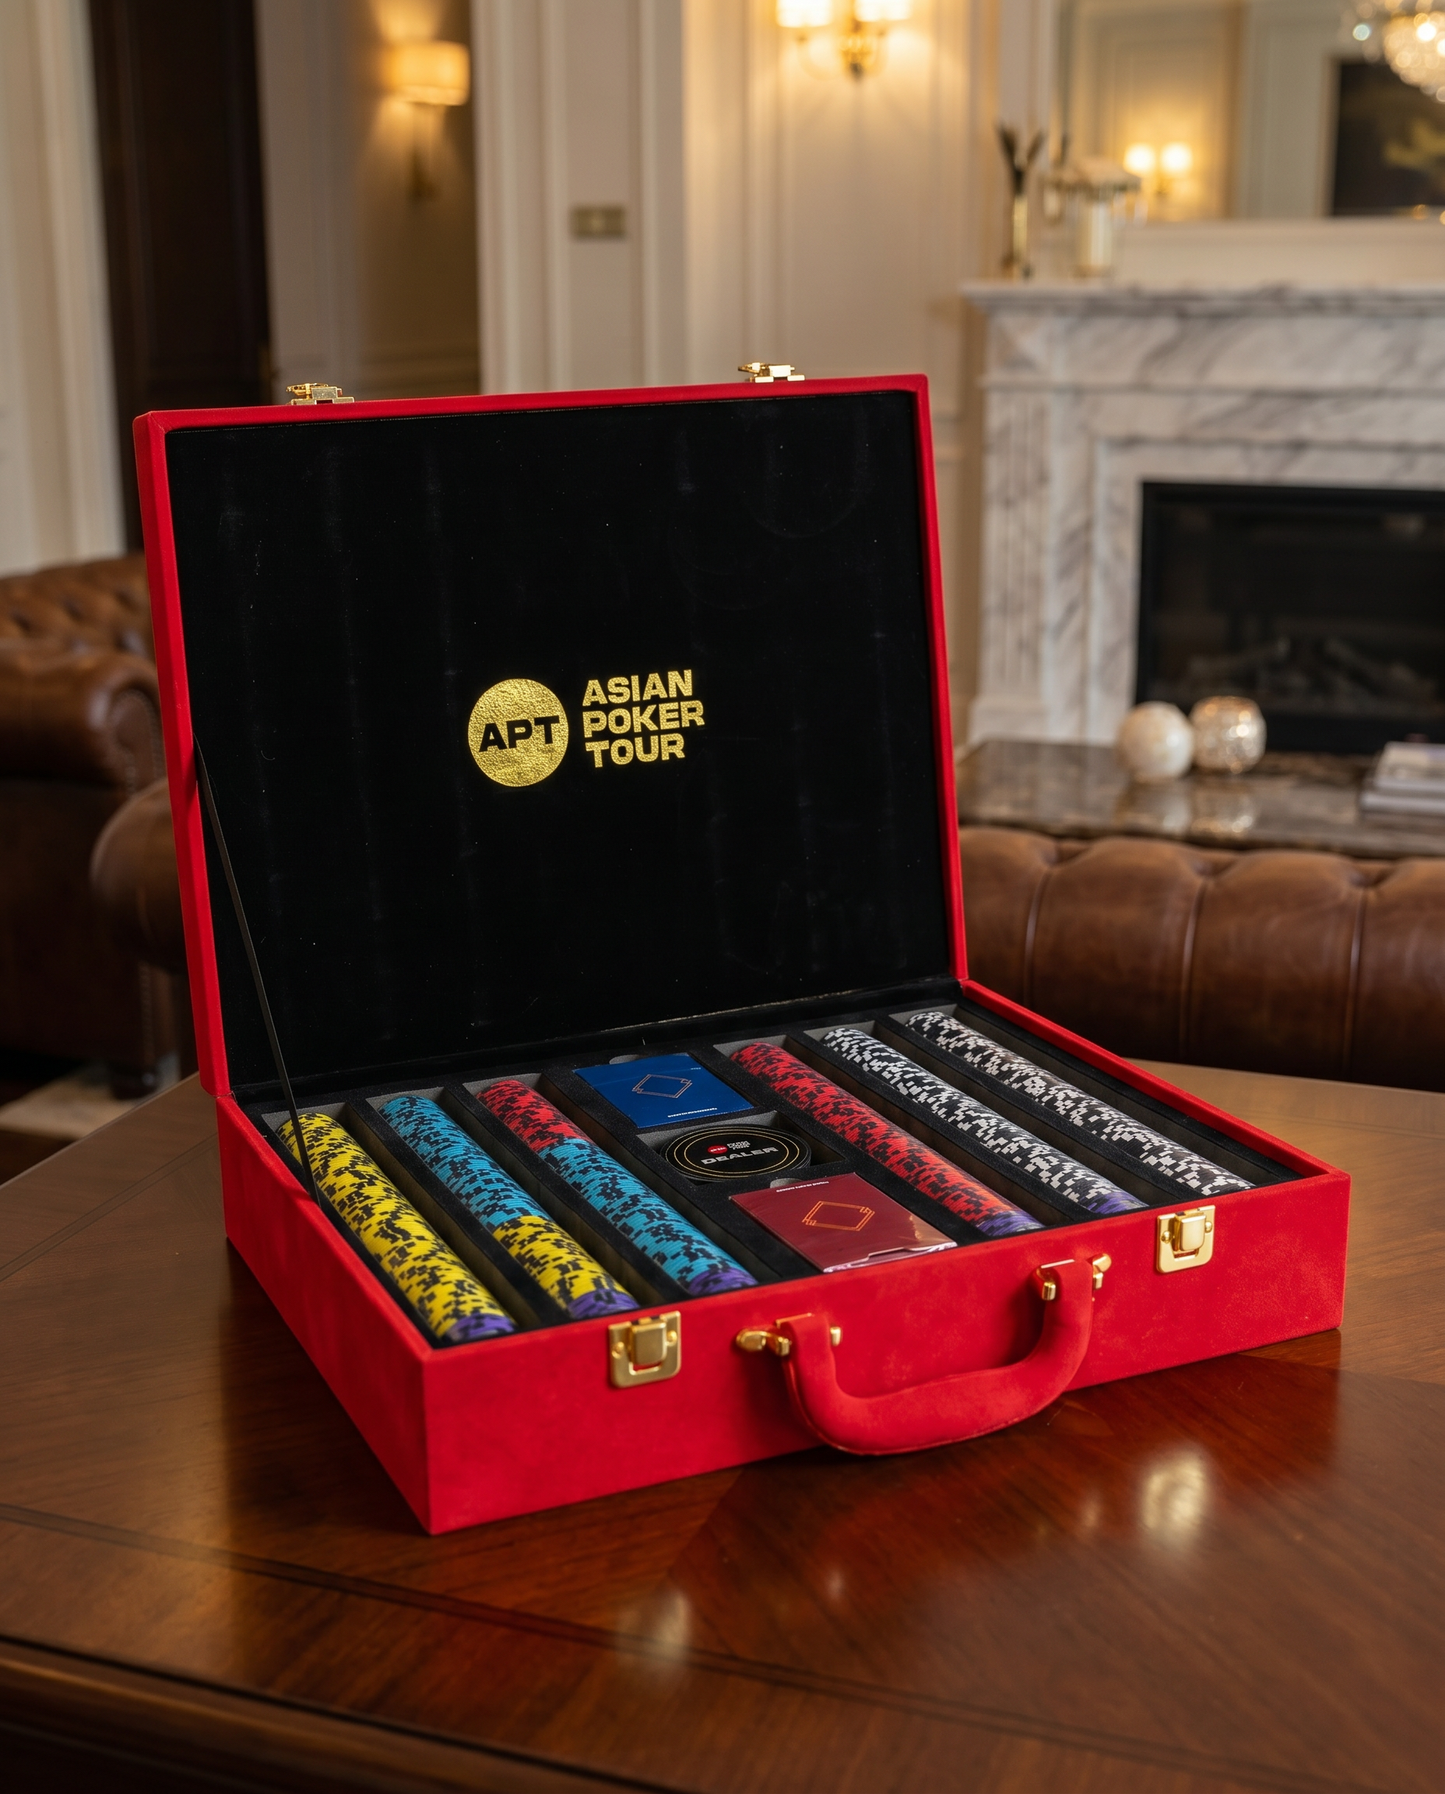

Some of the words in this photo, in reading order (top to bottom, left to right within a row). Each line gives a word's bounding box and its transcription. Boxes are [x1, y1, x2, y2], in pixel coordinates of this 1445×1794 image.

[582, 669, 692, 706] ASIAN
[479, 715, 559, 752] APT
[582, 700, 705, 738] POKER
[585, 733, 685, 768] TOUR
[701, 1146, 779, 1165] DEALER
